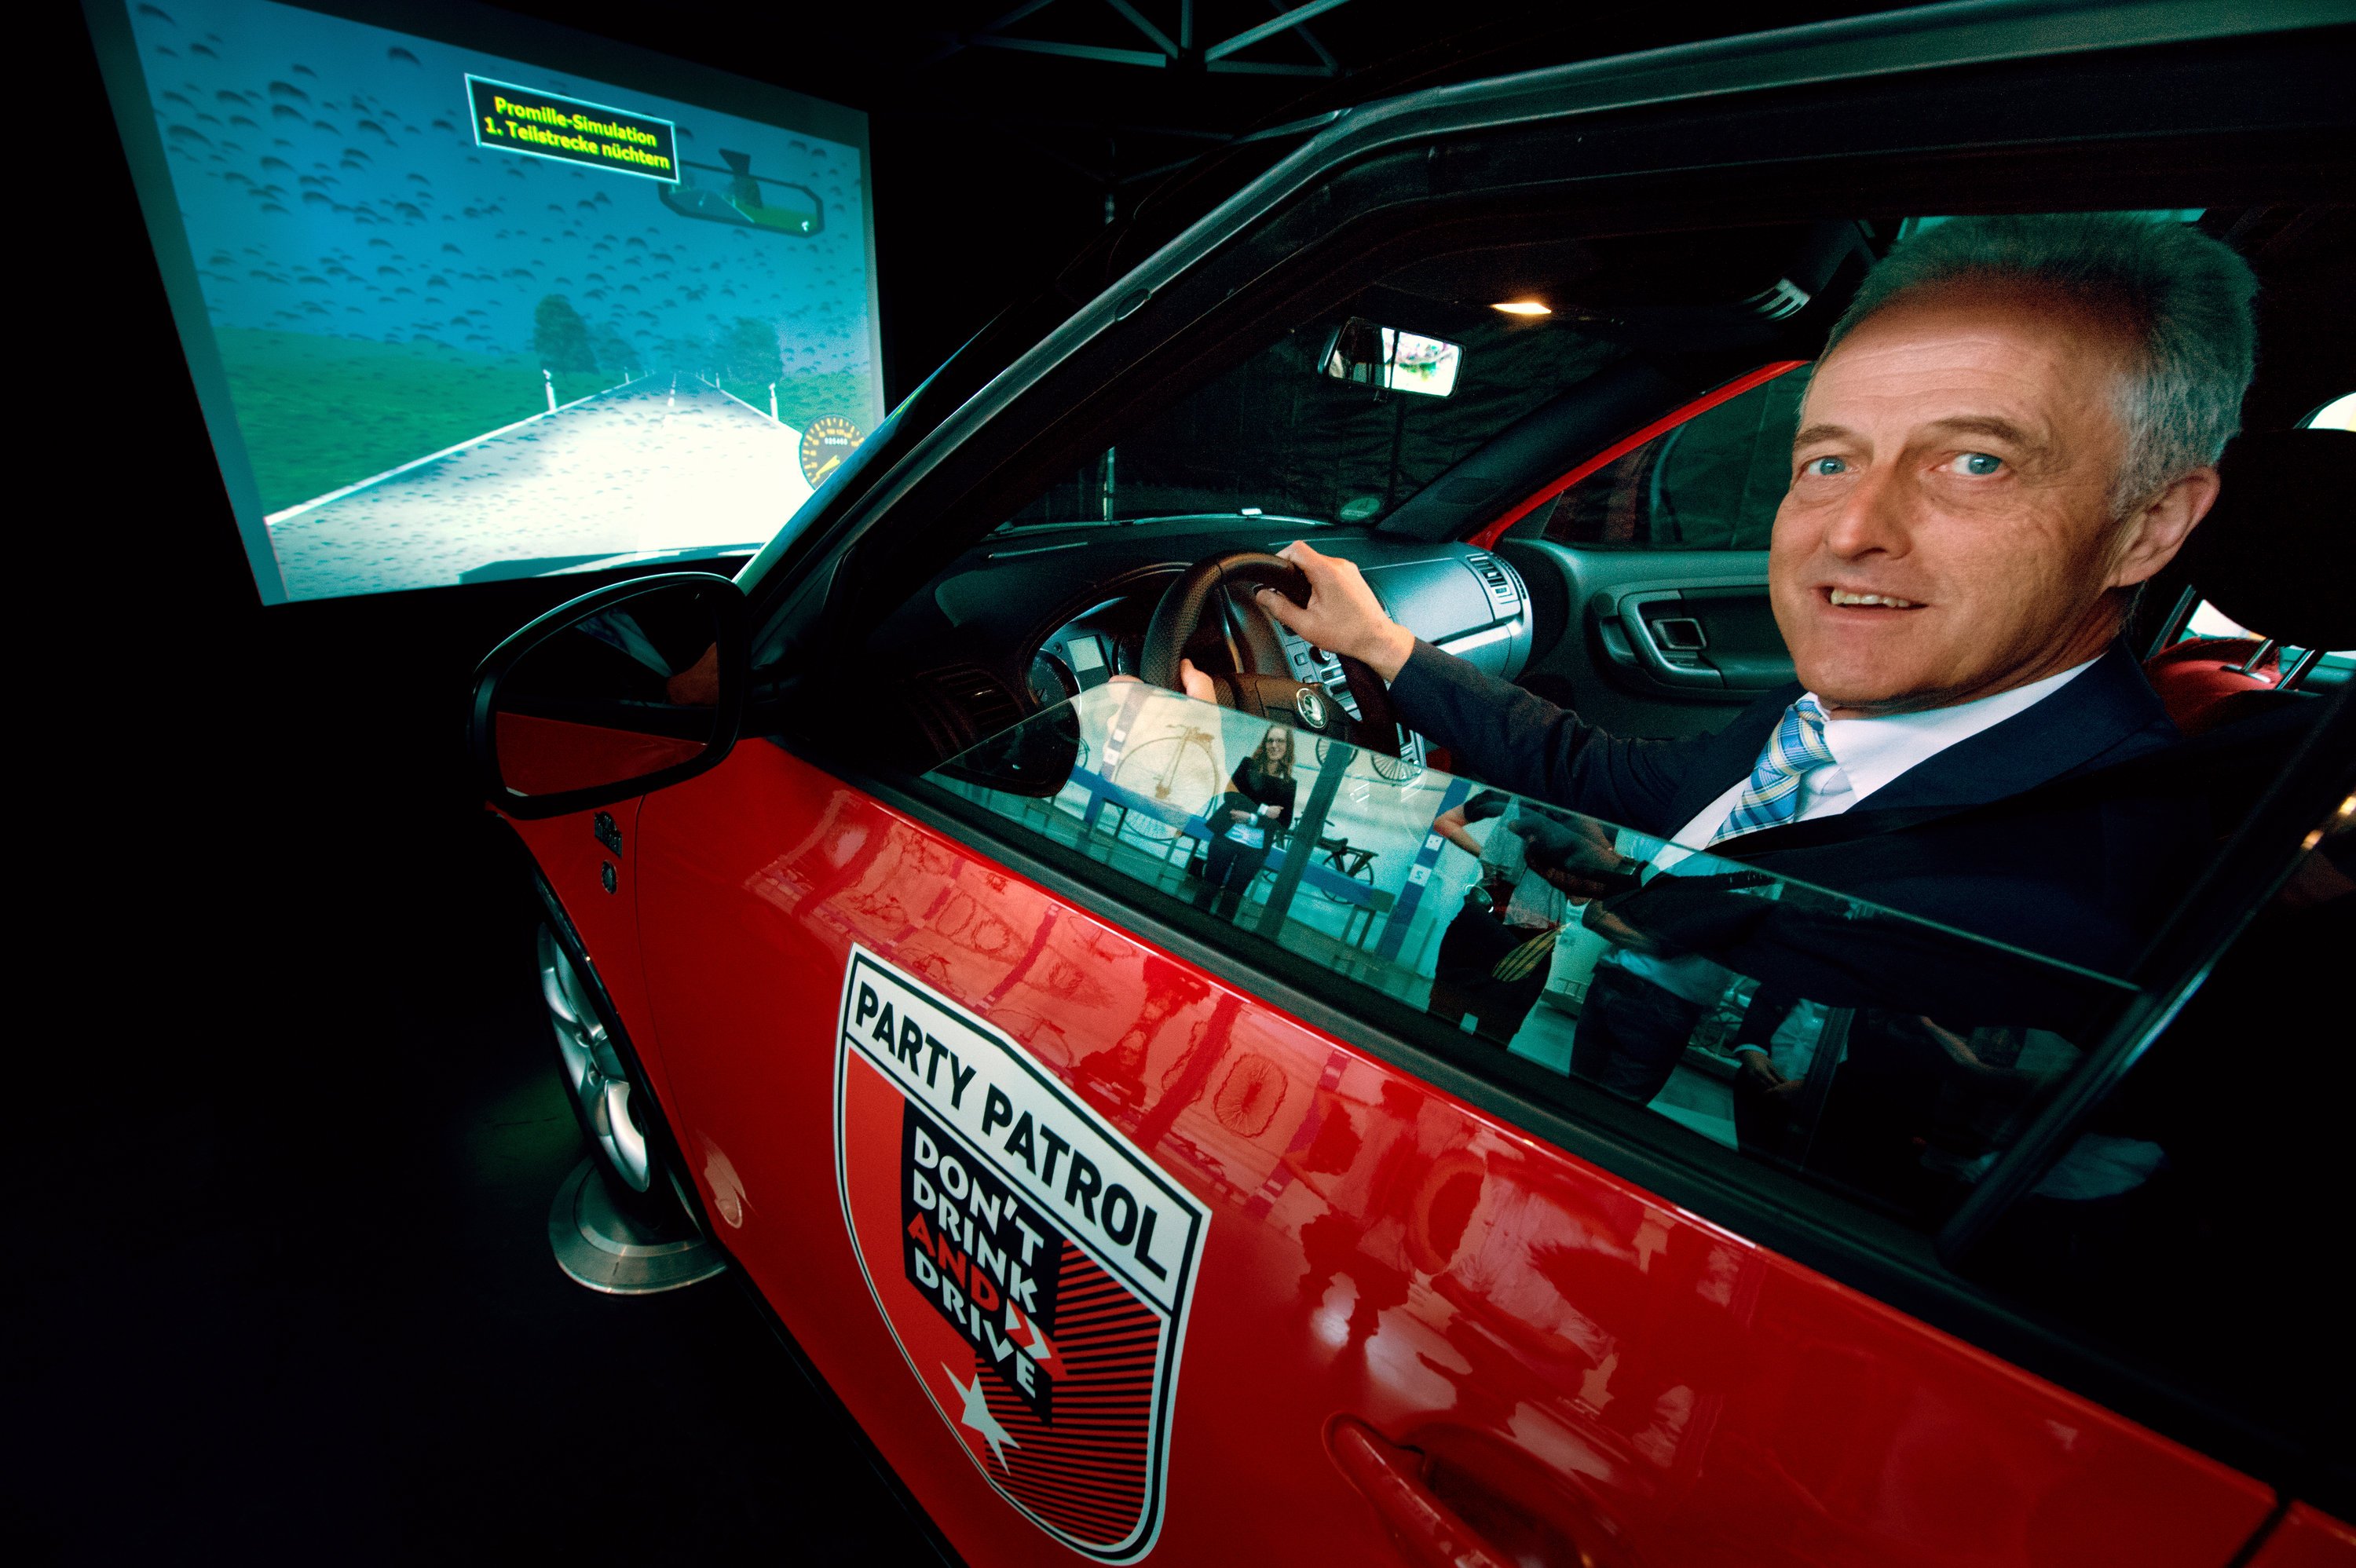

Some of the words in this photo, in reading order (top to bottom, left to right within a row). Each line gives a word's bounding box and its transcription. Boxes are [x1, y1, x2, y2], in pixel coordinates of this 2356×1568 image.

[484, 116, 503, 135] 1.
[505, 120, 599, 155] Teilstrecke
[602, 142, 671, 170] nüchtern
[493, 95, 657, 147] Promille-Simulation
[855, 981, 976, 1110] PARTY
[981, 1083, 1167, 1282] PATROL
[914, 1126, 1044, 1266] DON'T
[908, 1212, 1000, 1311] AND
[913, 1168, 1038, 1314] DRINK
[915, 1248, 1036, 1399] DRIVE
